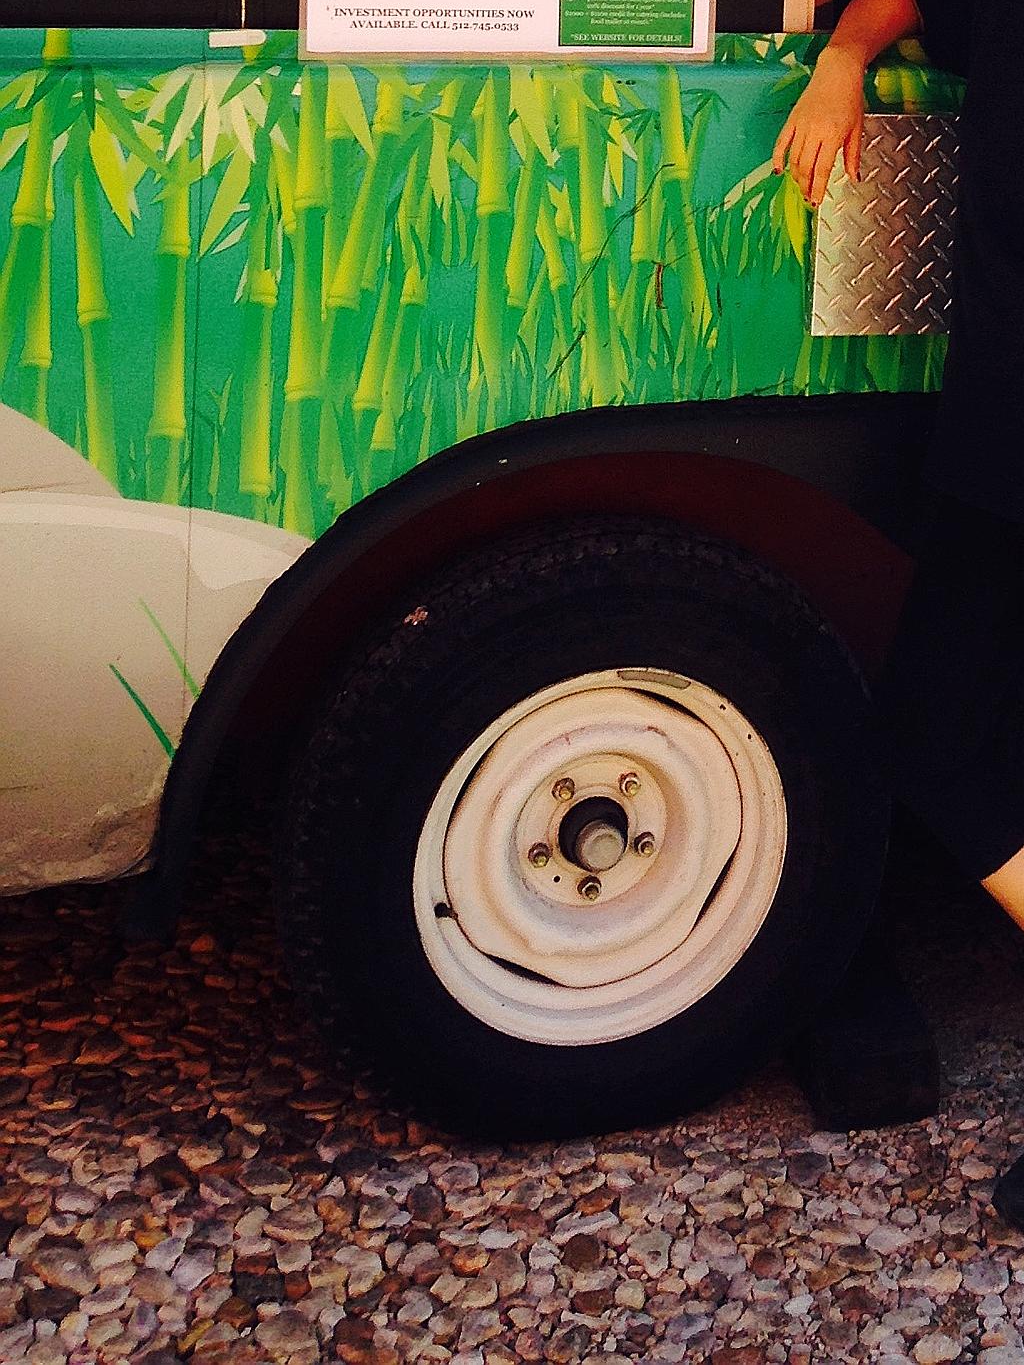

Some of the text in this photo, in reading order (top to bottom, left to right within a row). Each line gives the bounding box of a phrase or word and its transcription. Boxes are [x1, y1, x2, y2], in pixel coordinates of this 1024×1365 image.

[334, 8, 535, 19] INVESTMENT OPPORTUNITIES NOW
[421, 21, 450, 29] CALL
